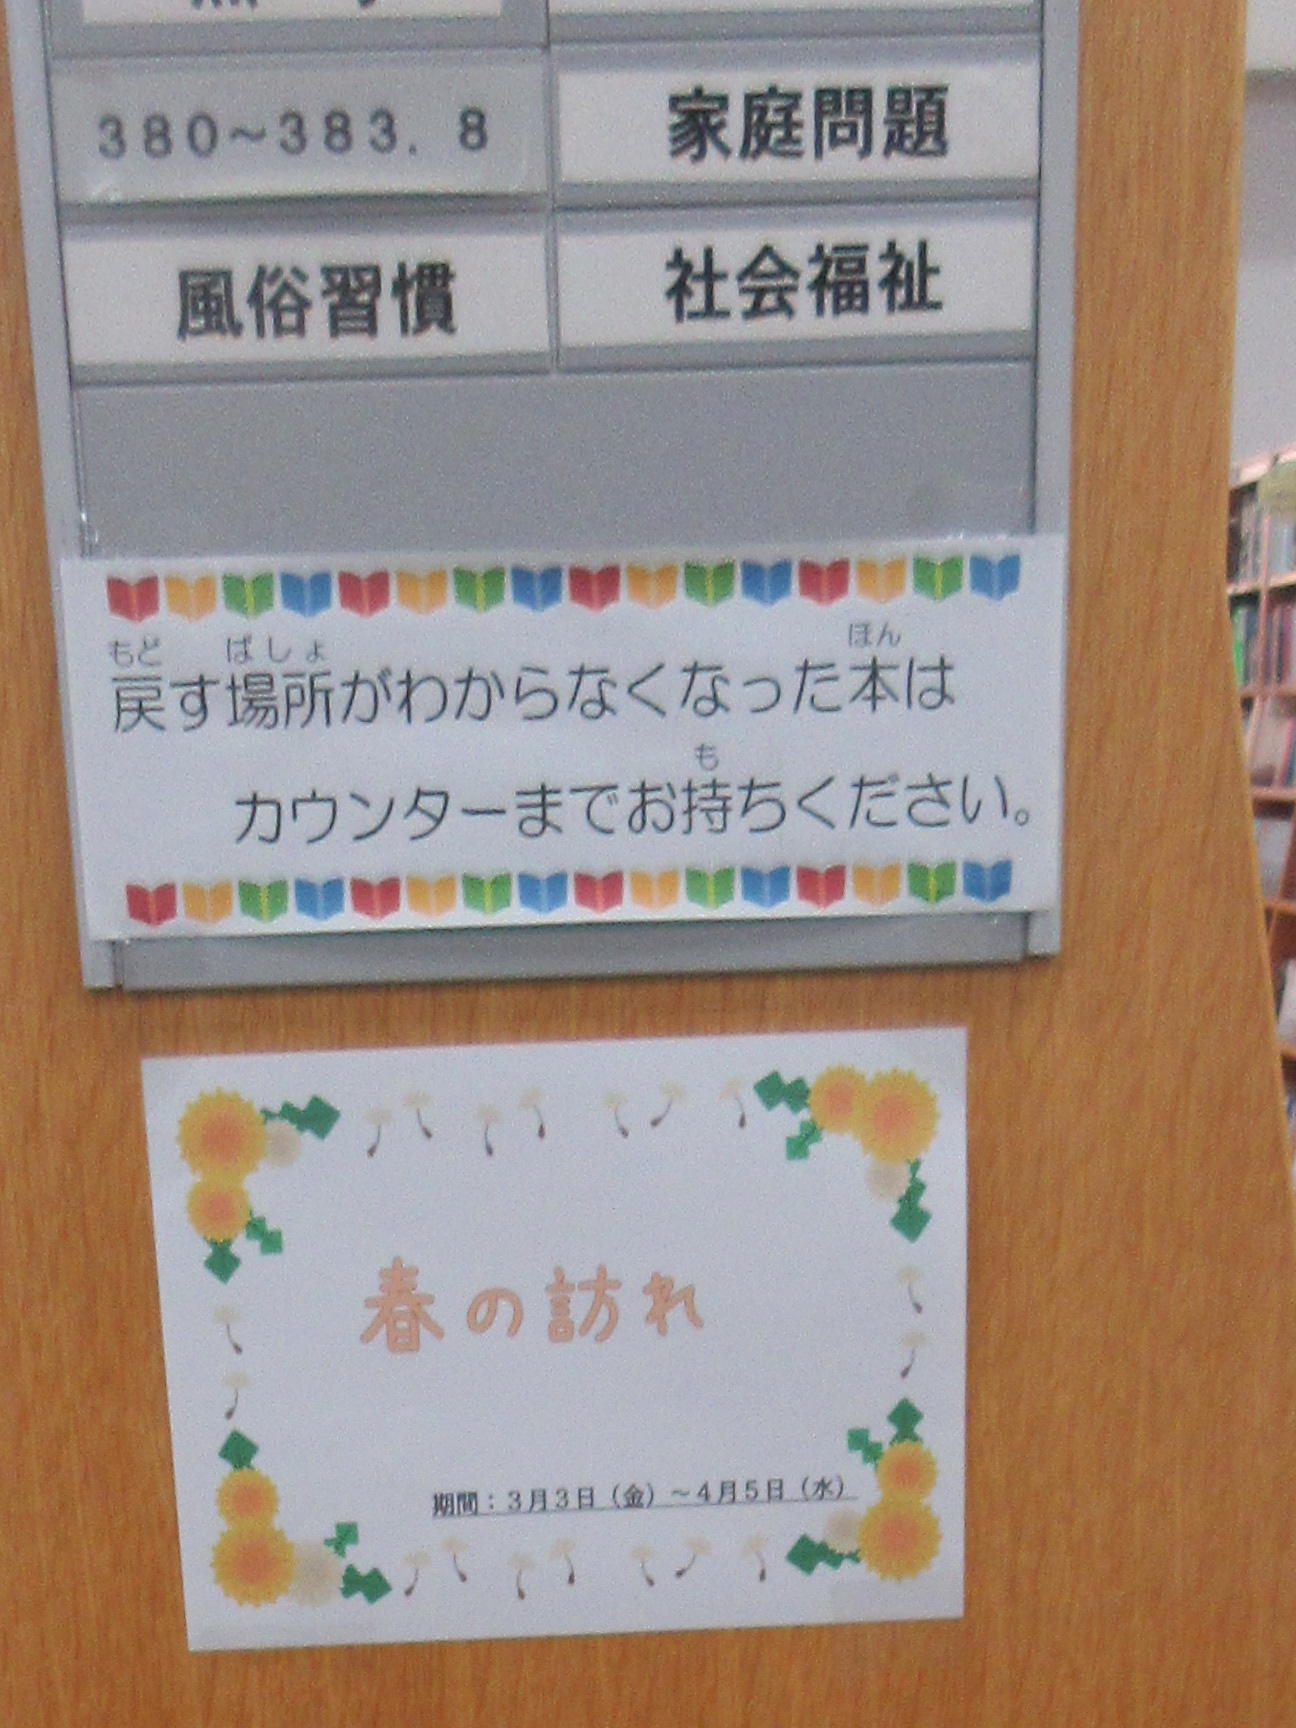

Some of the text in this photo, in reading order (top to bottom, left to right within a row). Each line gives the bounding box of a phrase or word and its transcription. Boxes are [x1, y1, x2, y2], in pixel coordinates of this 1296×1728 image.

[666, 83, 951, 164] 家庭問題
[174, 259, 459, 342] 風俗習慣
[664, 238, 945, 325] 社会福祉
[110, 635, 164, 668] もど
[224, 635, 328, 666] ばしょ
[846, 621, 903, 650] ほん
[111, 658, 957, 736] 戻す場所がわからなくなった本は
[693, 743, 722, 772] も
[233, 774, 1031, 847] カウンターまでお持ちください。
[360, 1256, 705, 1355] 春の訪れ
